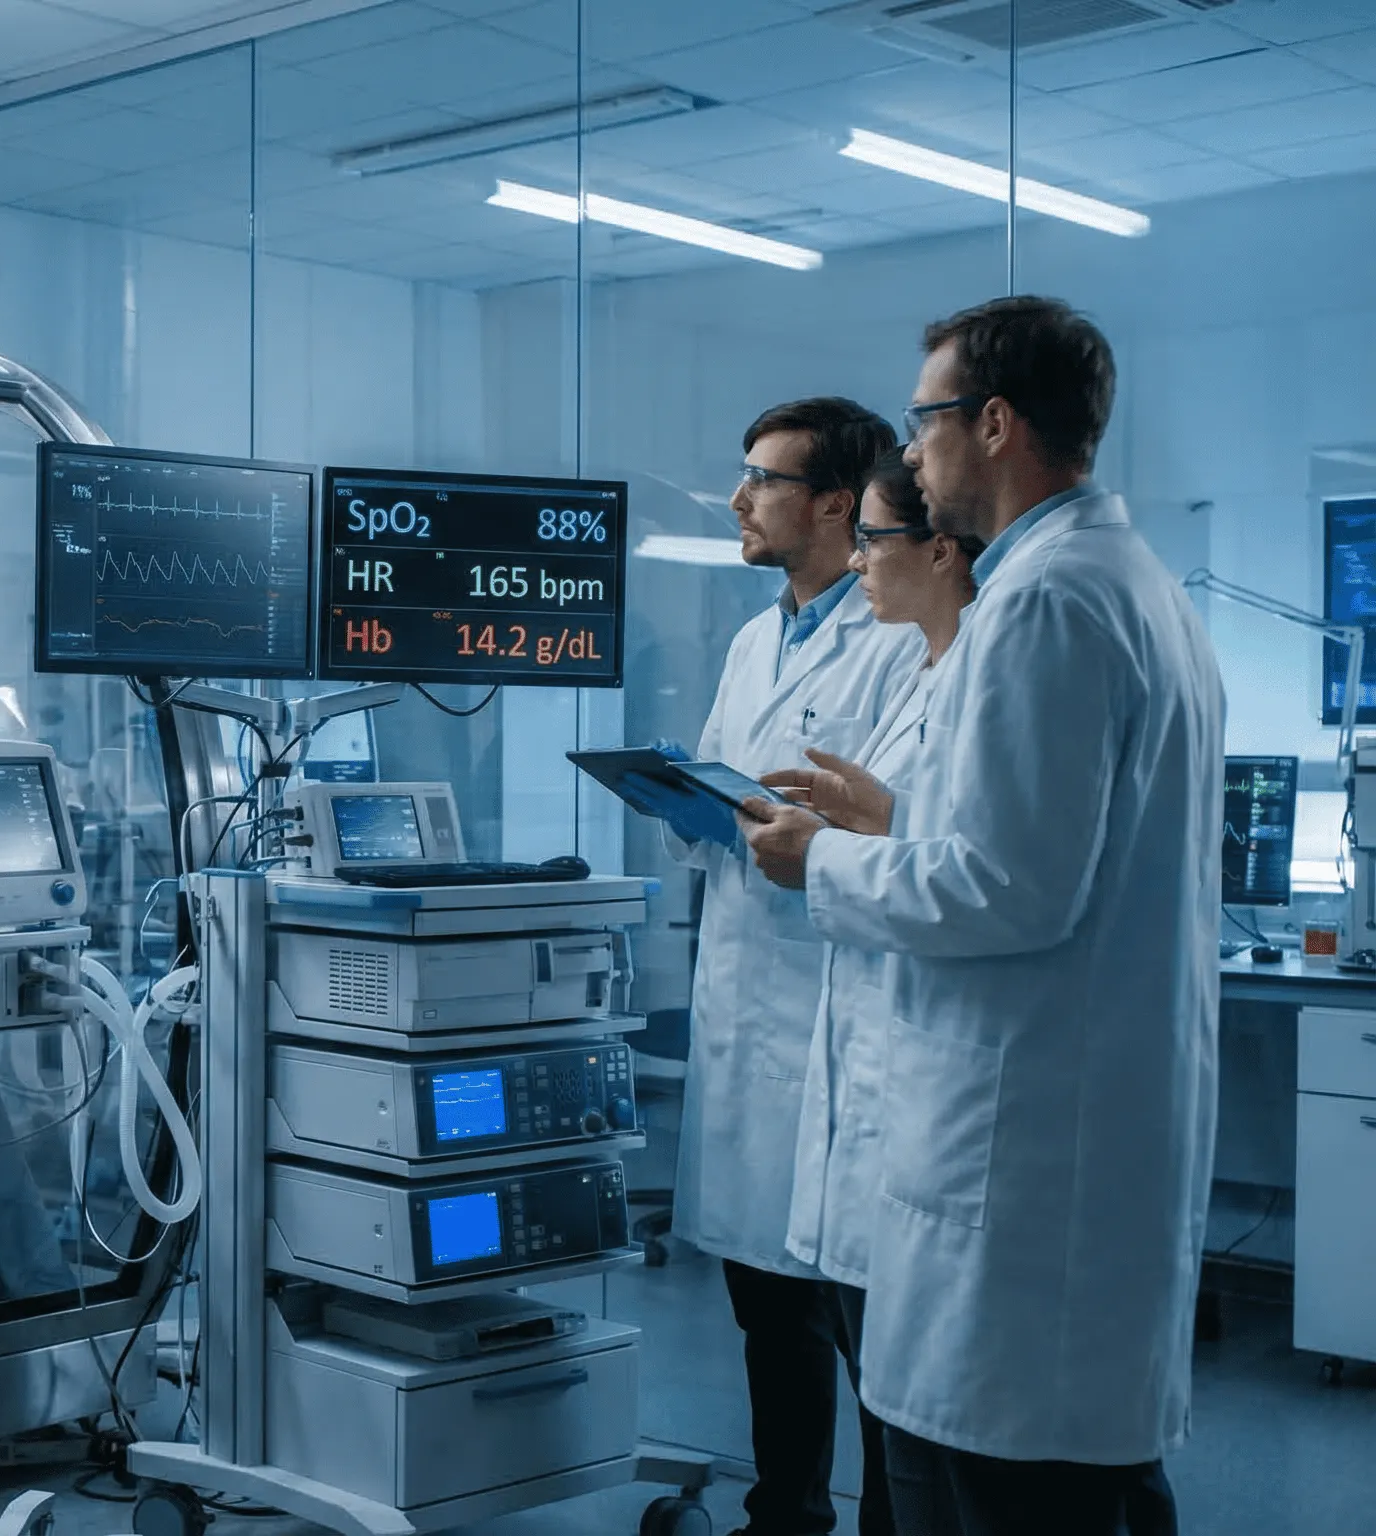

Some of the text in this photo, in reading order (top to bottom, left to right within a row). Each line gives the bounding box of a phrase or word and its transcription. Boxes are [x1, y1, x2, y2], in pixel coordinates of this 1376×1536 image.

[536, 508, 607, 543] 88%
[347, 559, 604, 606] HR 165 bpm
[345, 619, 602, 665] Hb 14.2 g/dL
